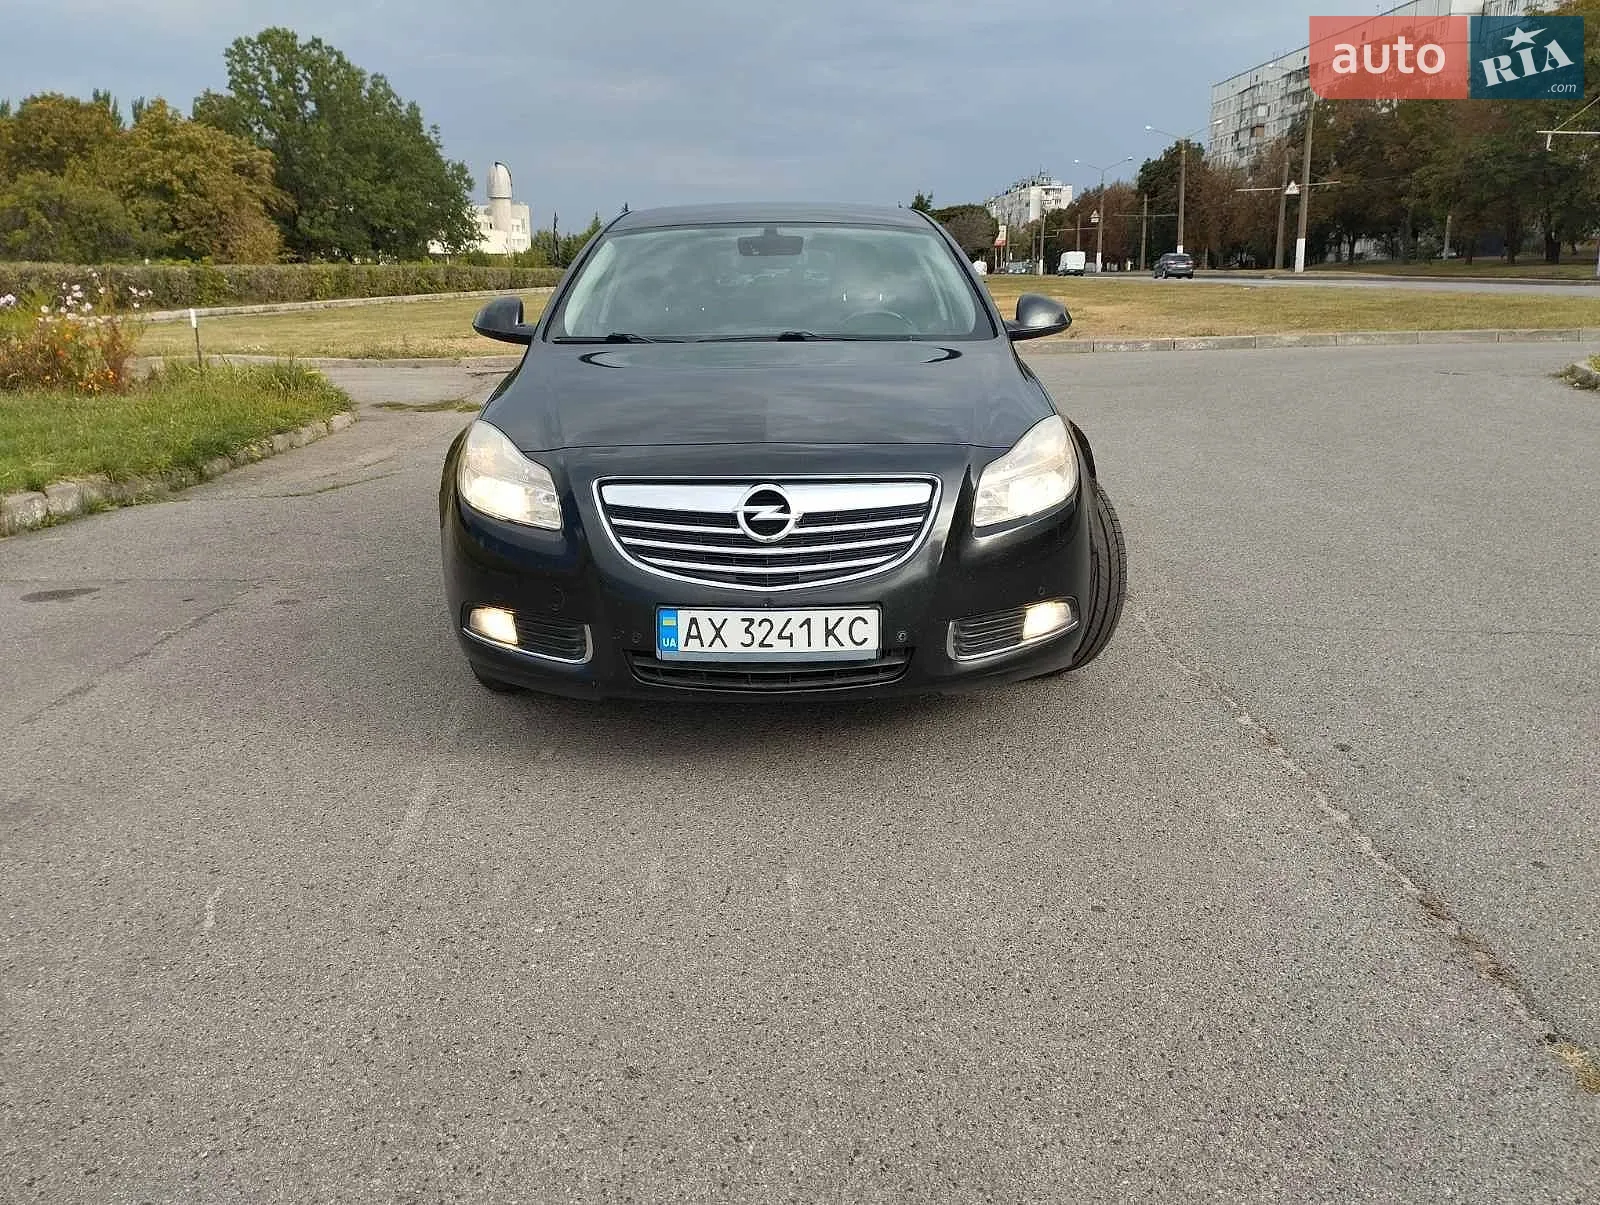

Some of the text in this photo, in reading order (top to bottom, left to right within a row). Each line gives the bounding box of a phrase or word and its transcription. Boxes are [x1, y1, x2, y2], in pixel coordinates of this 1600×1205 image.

[683, 616, 869, 648] AX 3241 KC
[662, 639, 678, 648] UA
